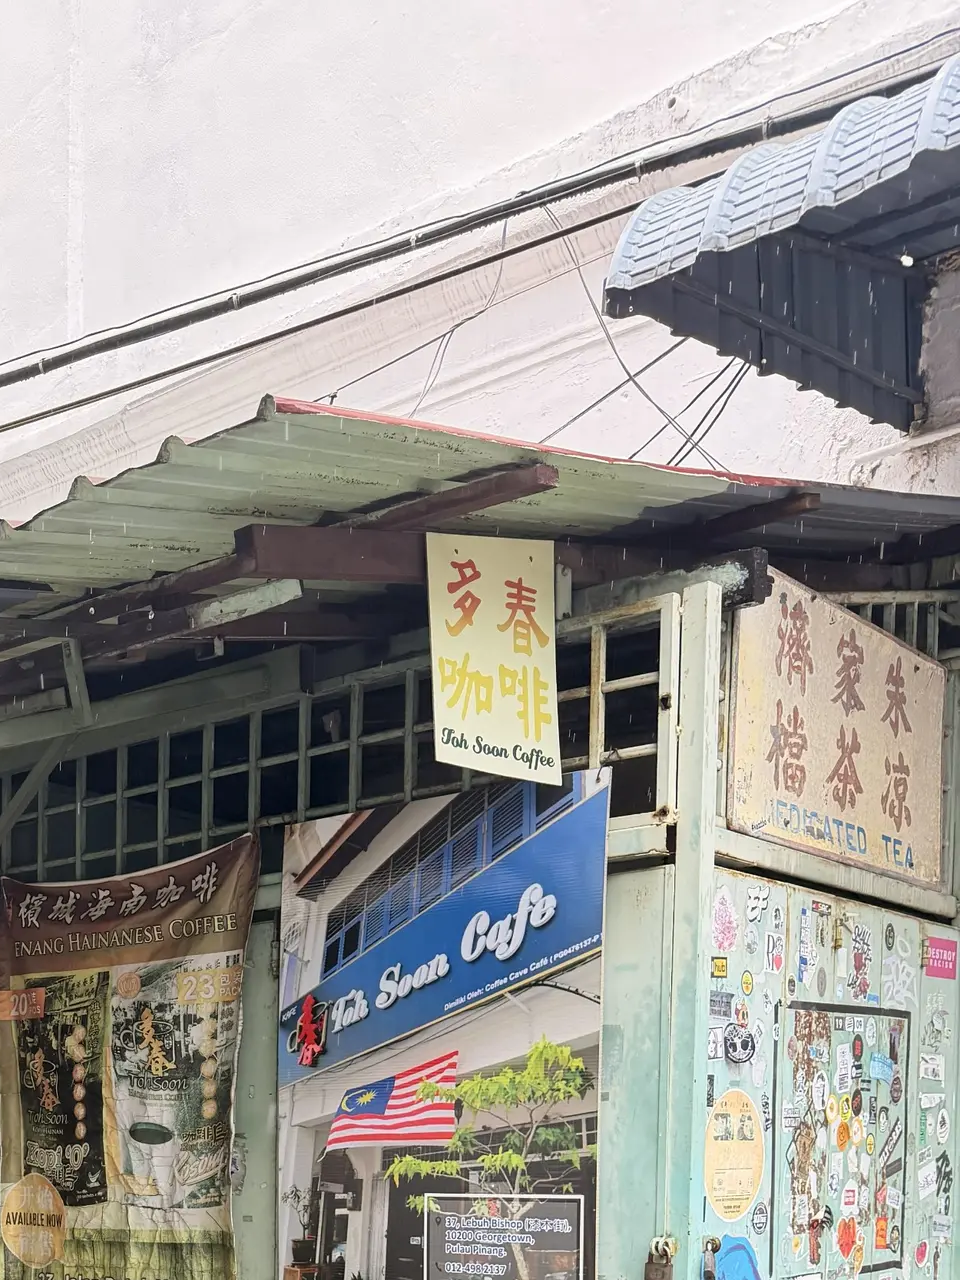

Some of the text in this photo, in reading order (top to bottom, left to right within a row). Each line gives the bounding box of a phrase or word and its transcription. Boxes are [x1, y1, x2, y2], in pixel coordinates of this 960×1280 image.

[438, 652, 551, 742] 咖啡
[441, 727, 555, 770] Toh Soon Coffee
[768, 799, 915, 870] EDICATED TEA
[460, 882, 557, 962] Cafe
[14, 913, 238, 958] ENANG HAINANESE COFFEE
[928, 947, 956, 961] DESTROY
[183, 974, 216, 1001] 23
[375, 952, 450, 1010] Soon
[485, 977, 508, 991] Coffee
[10, 993, 27, 1016] 20
[331, 989, 369, 1033] Toh
[6, 1212, 63, 1228] AVAILABLE NOW
[461, 1218, 490, 1229] Lebuh
[490, 1218, 523, 1231] Bishop
[445, 1231, 535, 1246] 10200 Georgetown,
[445, 1245, 507, 1257] Pulau Pinang.
[483, 1264, 506, 1276] 2137
